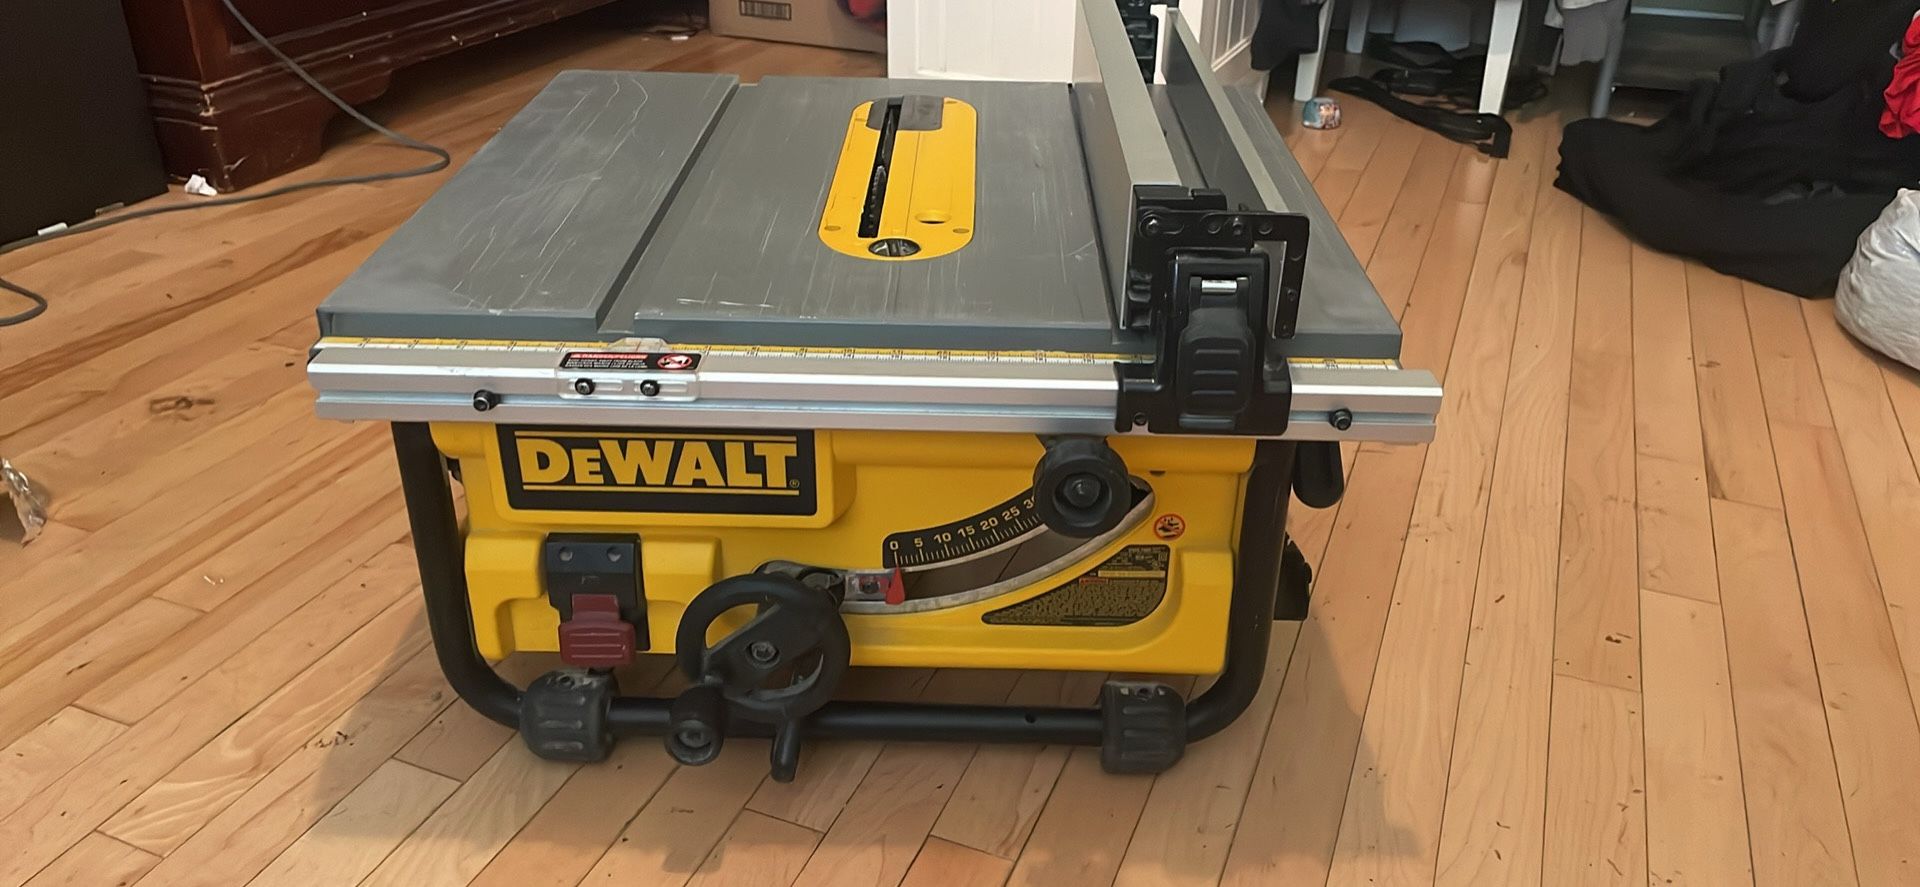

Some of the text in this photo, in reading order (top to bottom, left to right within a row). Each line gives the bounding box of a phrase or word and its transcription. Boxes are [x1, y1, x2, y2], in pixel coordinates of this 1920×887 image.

[889, 540, 899, 551] 0
[914, 537, 924, 548] 5
[933, 532, 952, 544] 10
[957, 525, 976, 538] 15
[979, 516, 999, 531] 20
[1001, 506, 1021, 521] 25
